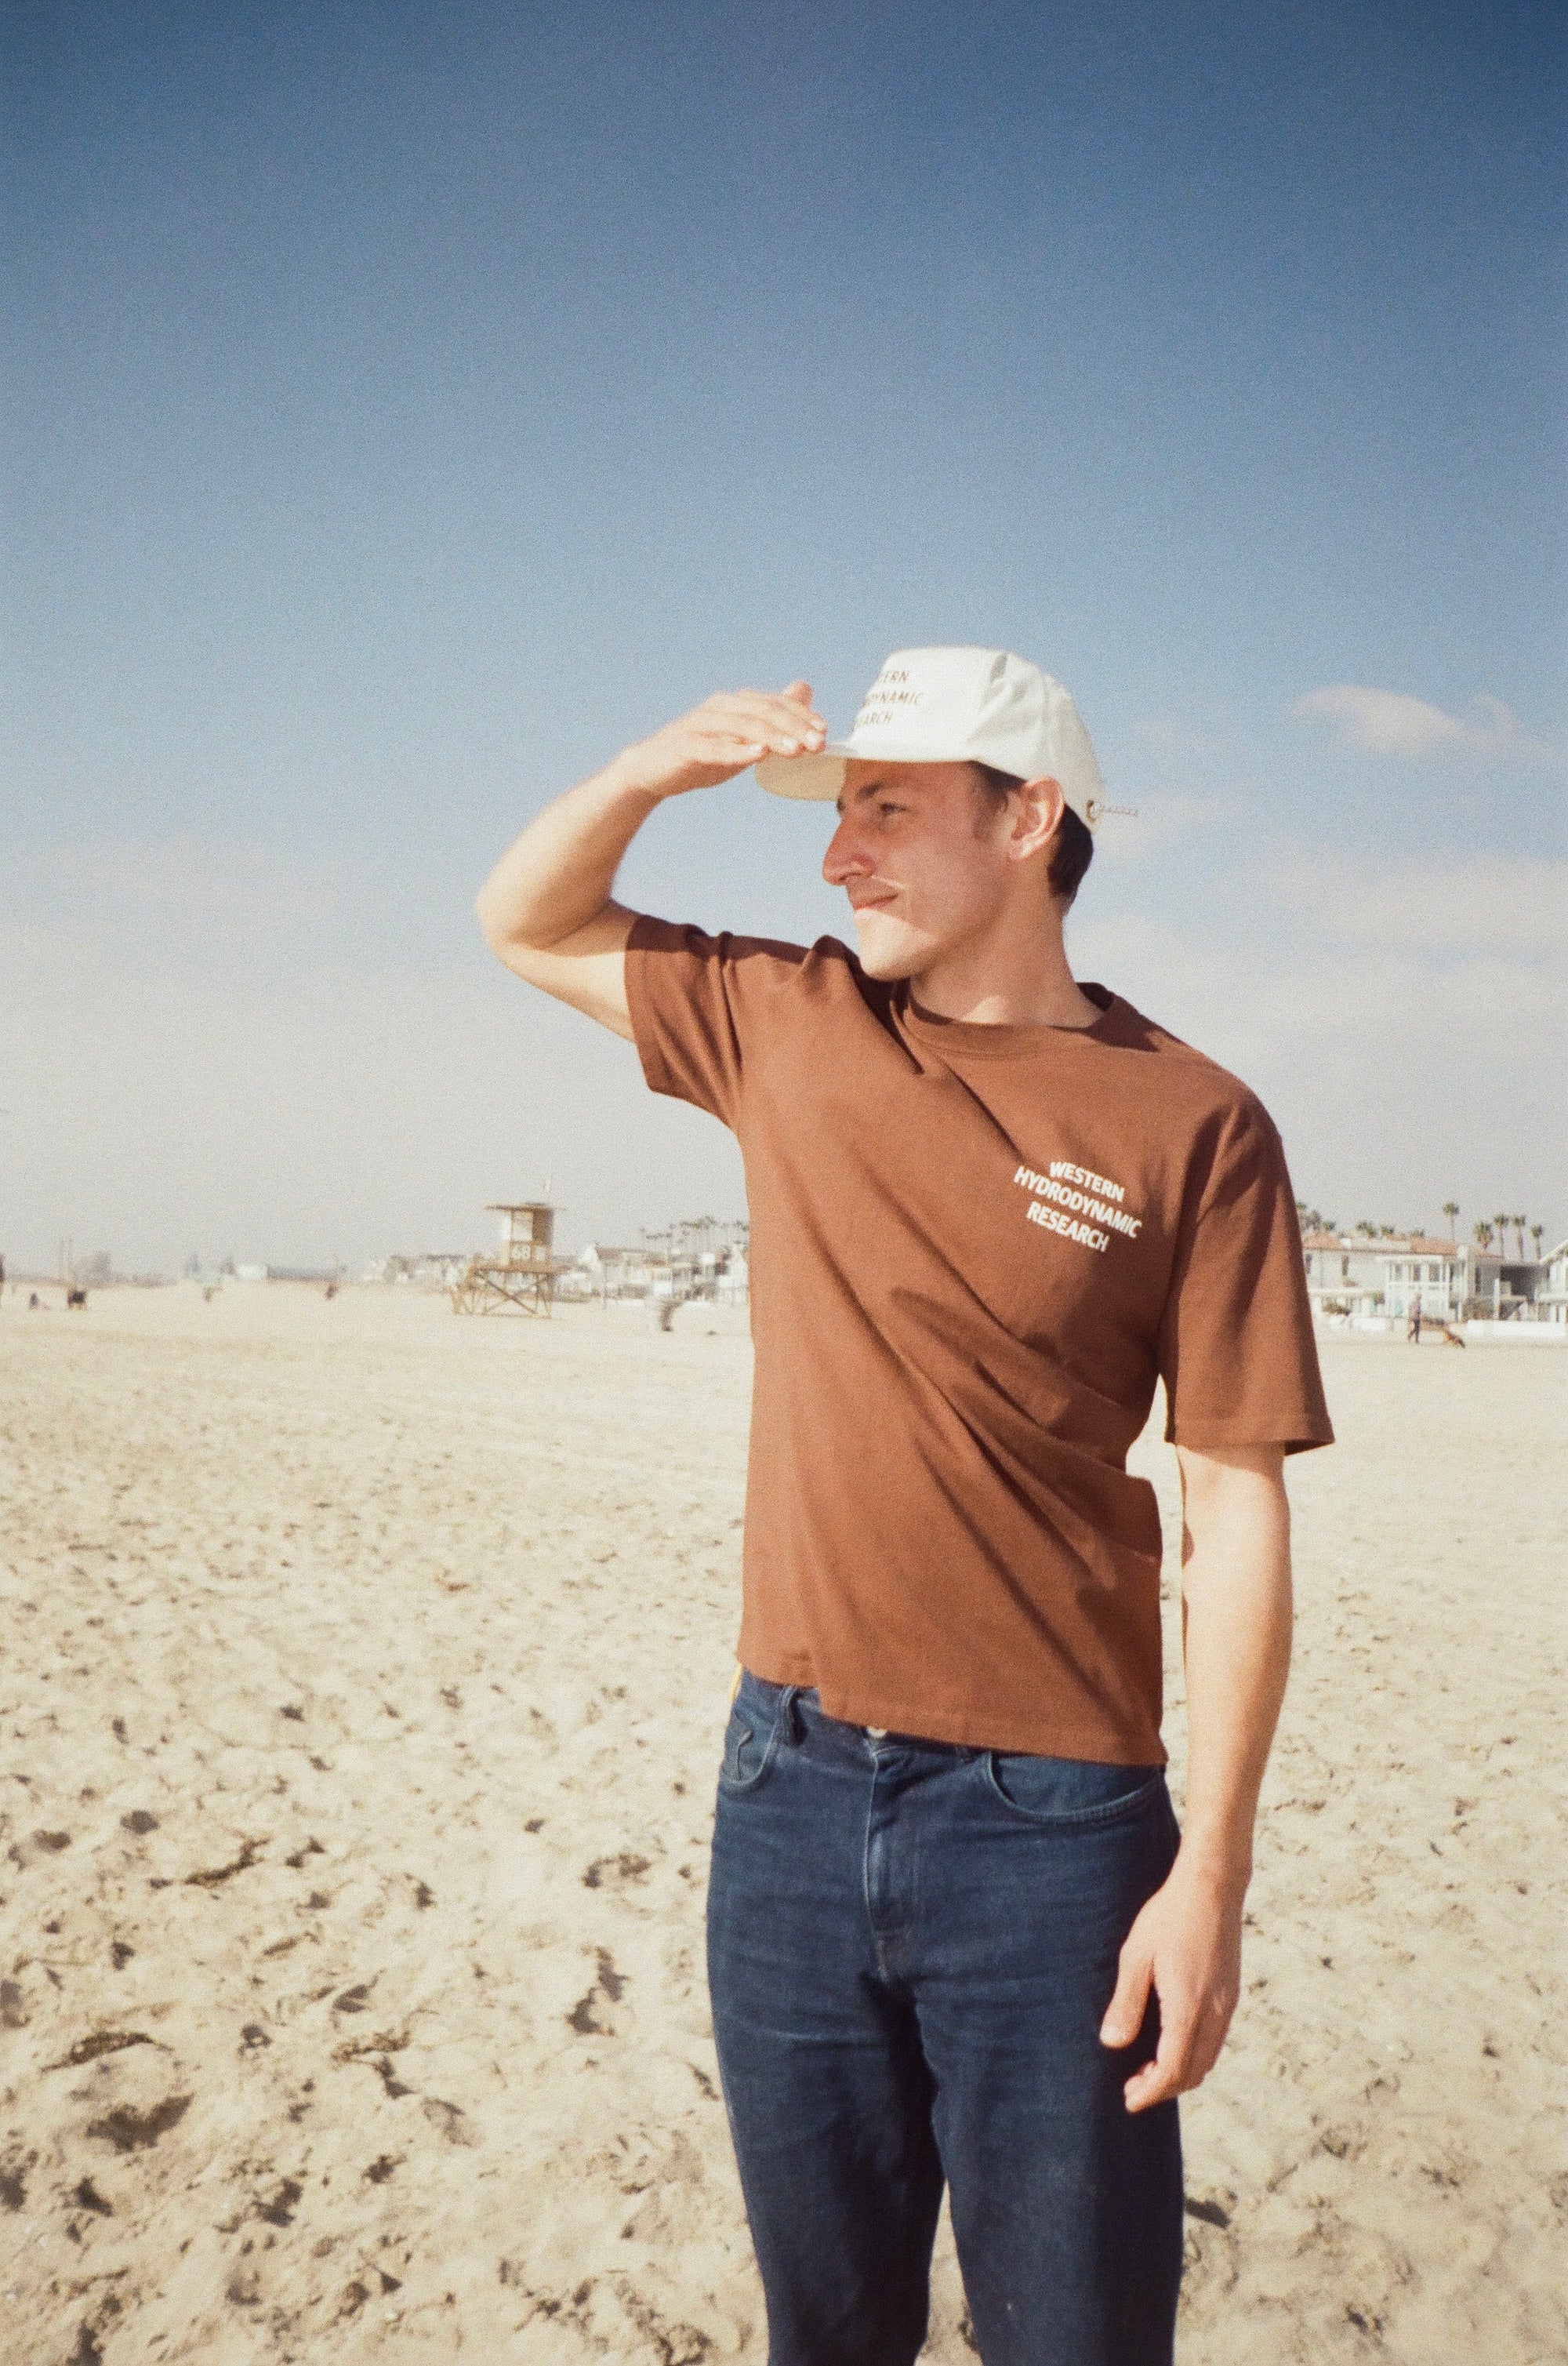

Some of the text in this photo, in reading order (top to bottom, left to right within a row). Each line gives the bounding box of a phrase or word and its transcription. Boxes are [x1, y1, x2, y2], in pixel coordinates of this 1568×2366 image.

[1013, 1165, 1142, 1238] HYDRODYNAMIC
[1049, 1161, 1125, 1202] WESTERN
[1025, 1201, 1110, 1252] RESEARCH
